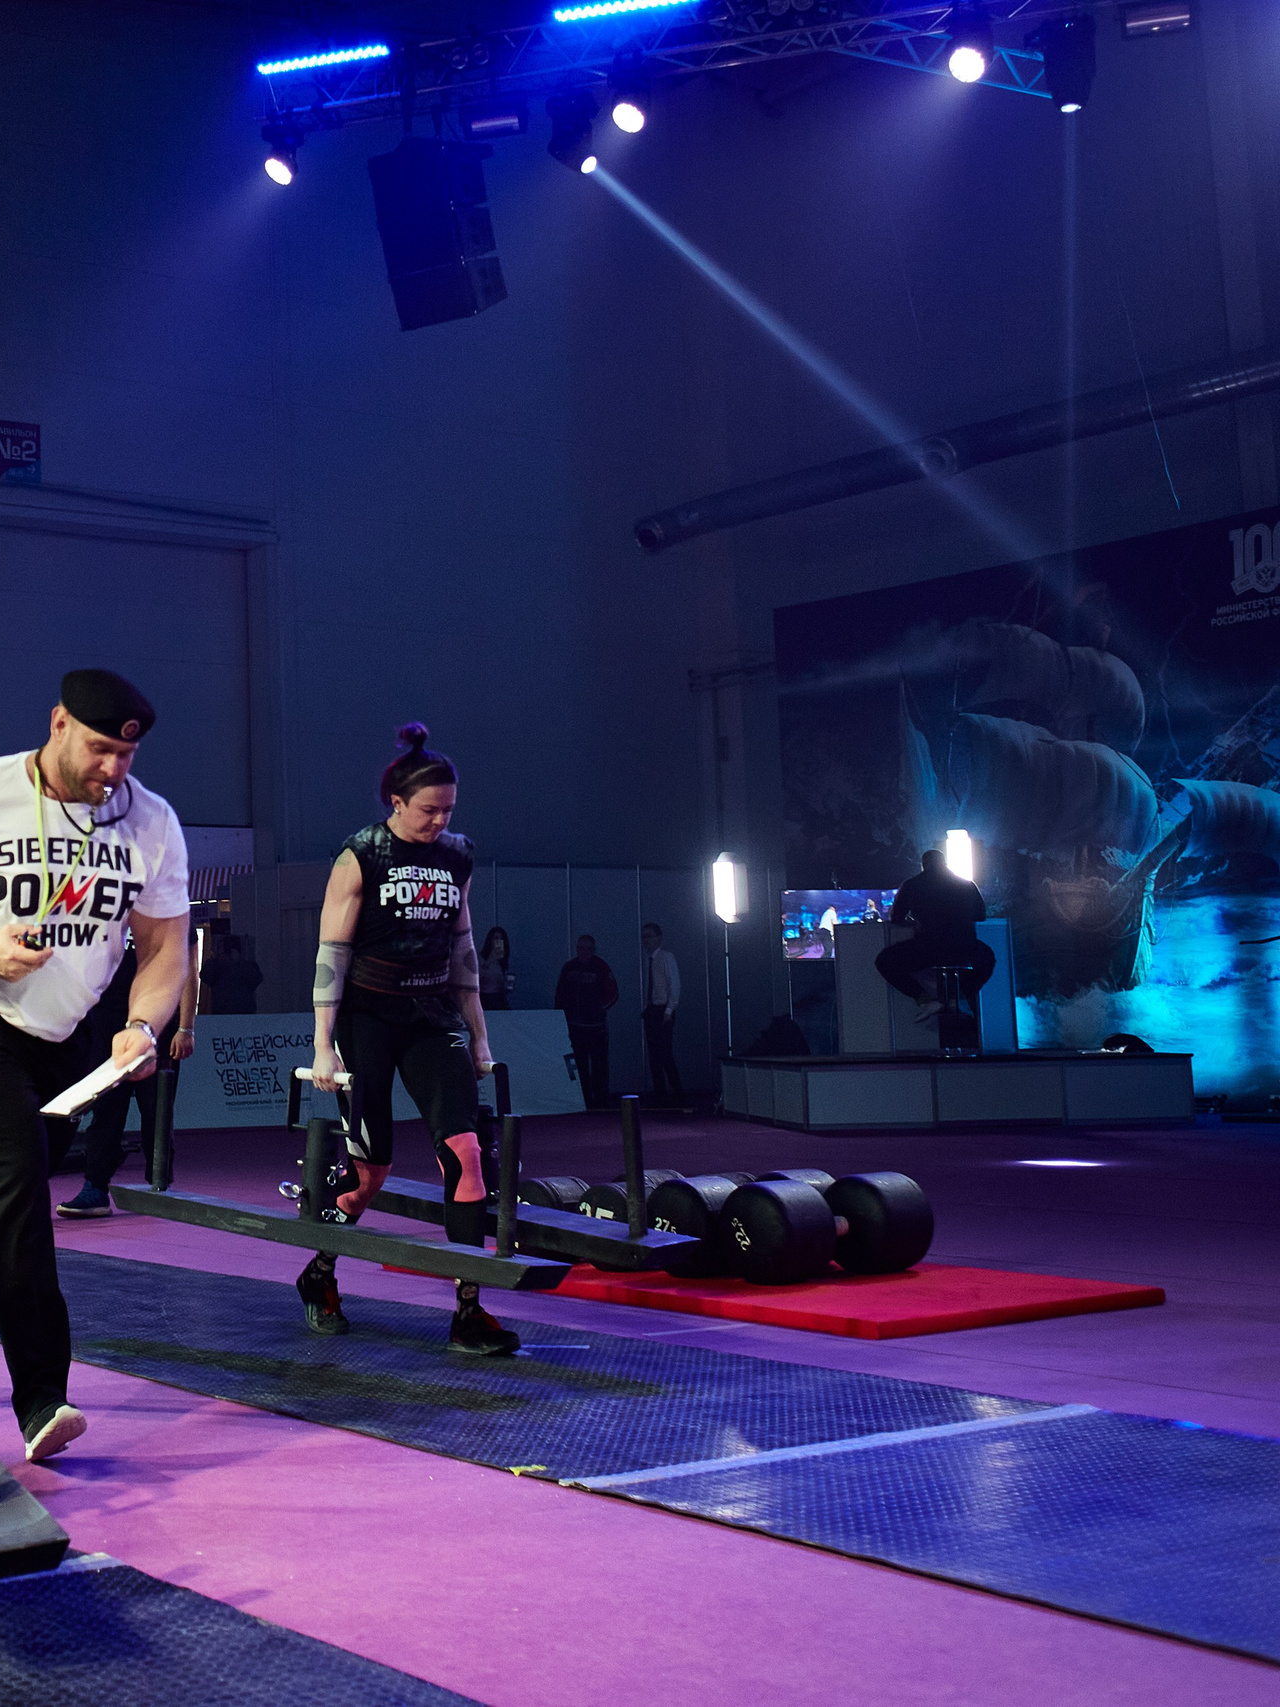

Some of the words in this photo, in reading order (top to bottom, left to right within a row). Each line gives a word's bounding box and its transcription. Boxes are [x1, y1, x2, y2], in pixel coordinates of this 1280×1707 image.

[387, 865, 453, 884] SIBERIAN
[379, 881, 460, 909] POWER
[404, 906, 442, 920] SHOW
[40, 923, 99, 947] HOW
[212, 1034, 314, 1051] ЕНИСЕЙСКАЯ
[214, 1050, 276, 1064] СИБИРЬ
[216, 1067, 278, 1082] YENISEY
[223, 1081, 284, 1096] SIBERIA
